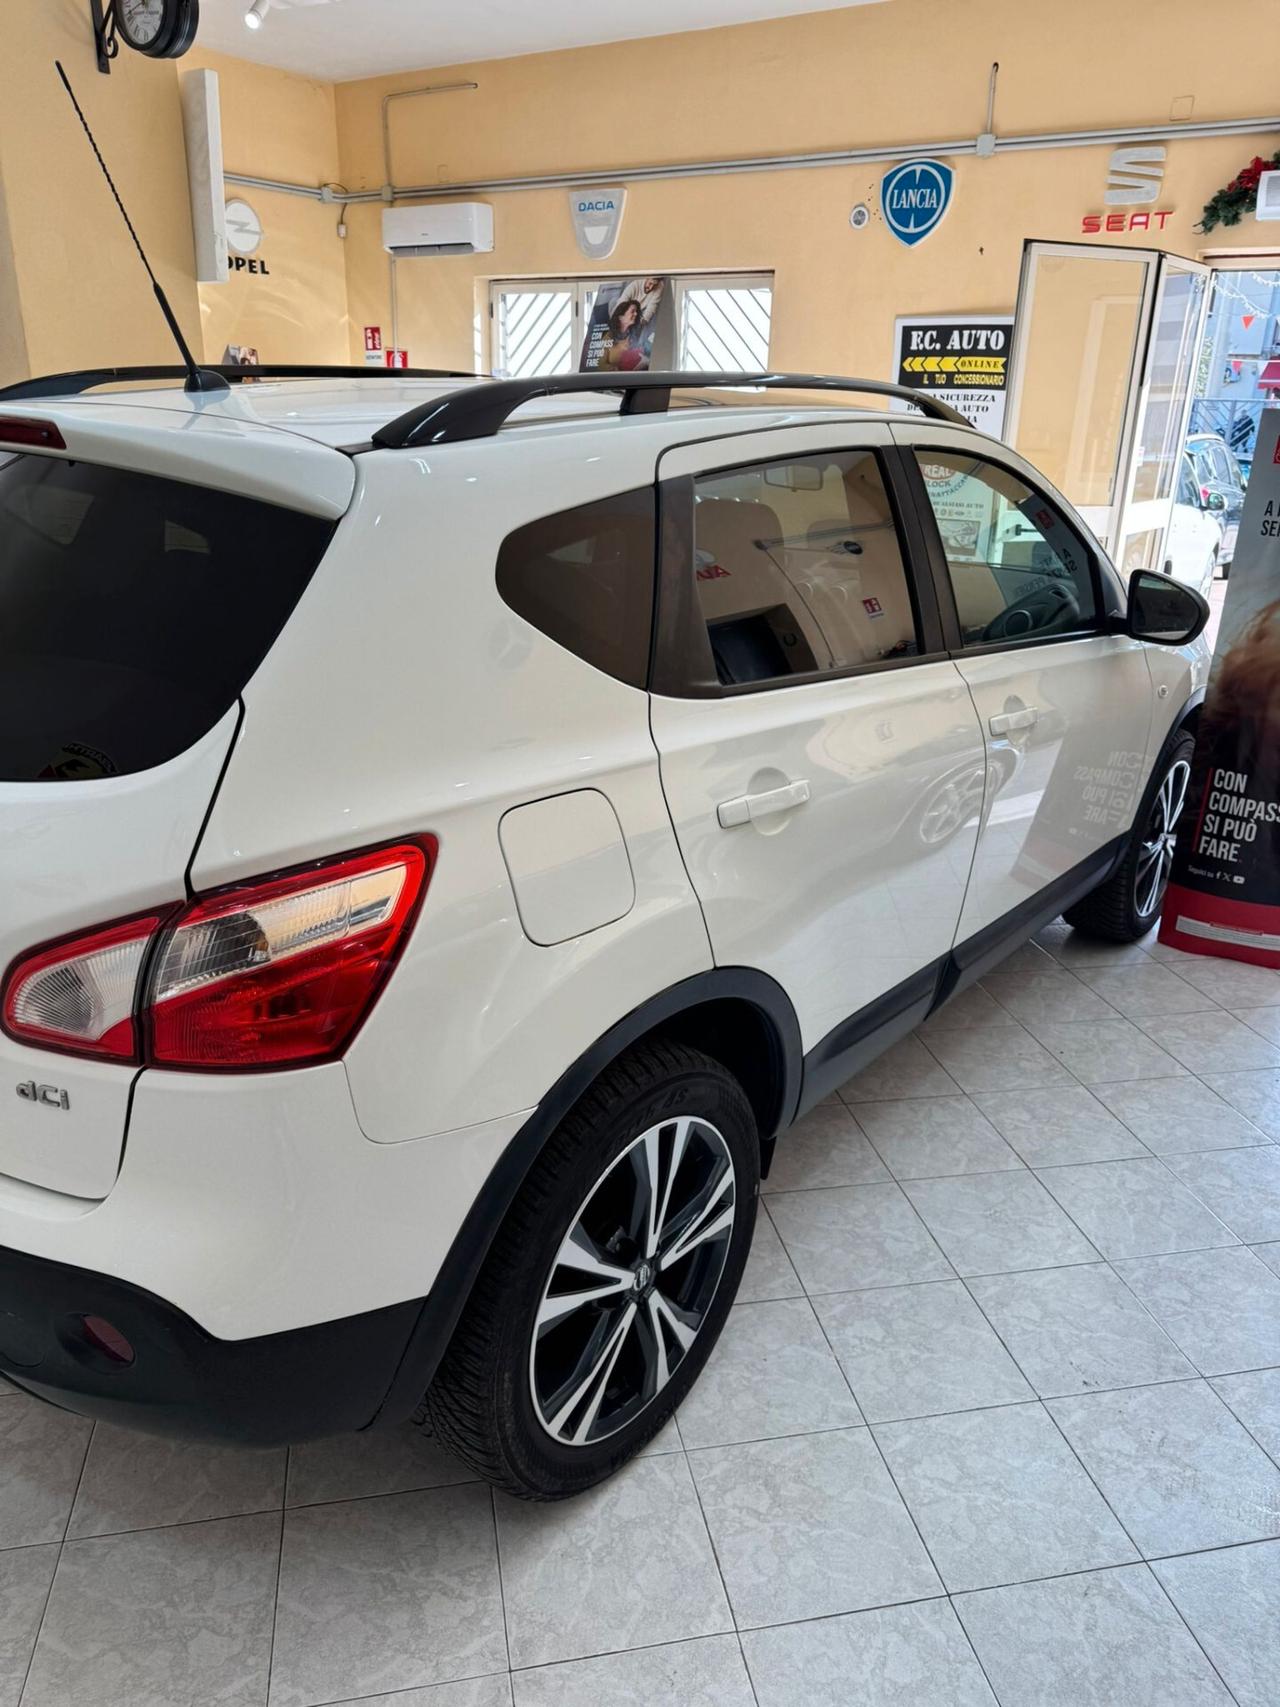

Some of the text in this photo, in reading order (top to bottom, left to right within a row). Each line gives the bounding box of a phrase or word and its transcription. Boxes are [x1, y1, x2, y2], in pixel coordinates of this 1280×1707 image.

[578, 200, 615, 212] DACIA
[892, 188, 938, 209] LANCIA
[1081, 211, 1174, 234] SEAT
[910, 330, 1005, 351] F.C. AUTO
[960, 359, 1000, 369] ONLINE
[935, 373, 947, 384] TUO
[953, 374, 1005, 386] CONCESSIONARIO
[940, 393, 996, 402] SICUREZZA
[961, 404, 990, 413] AUTO
[1213, 768, 1248, 794] CON
[1203, 813, 1258, 842] SI PUÒ
